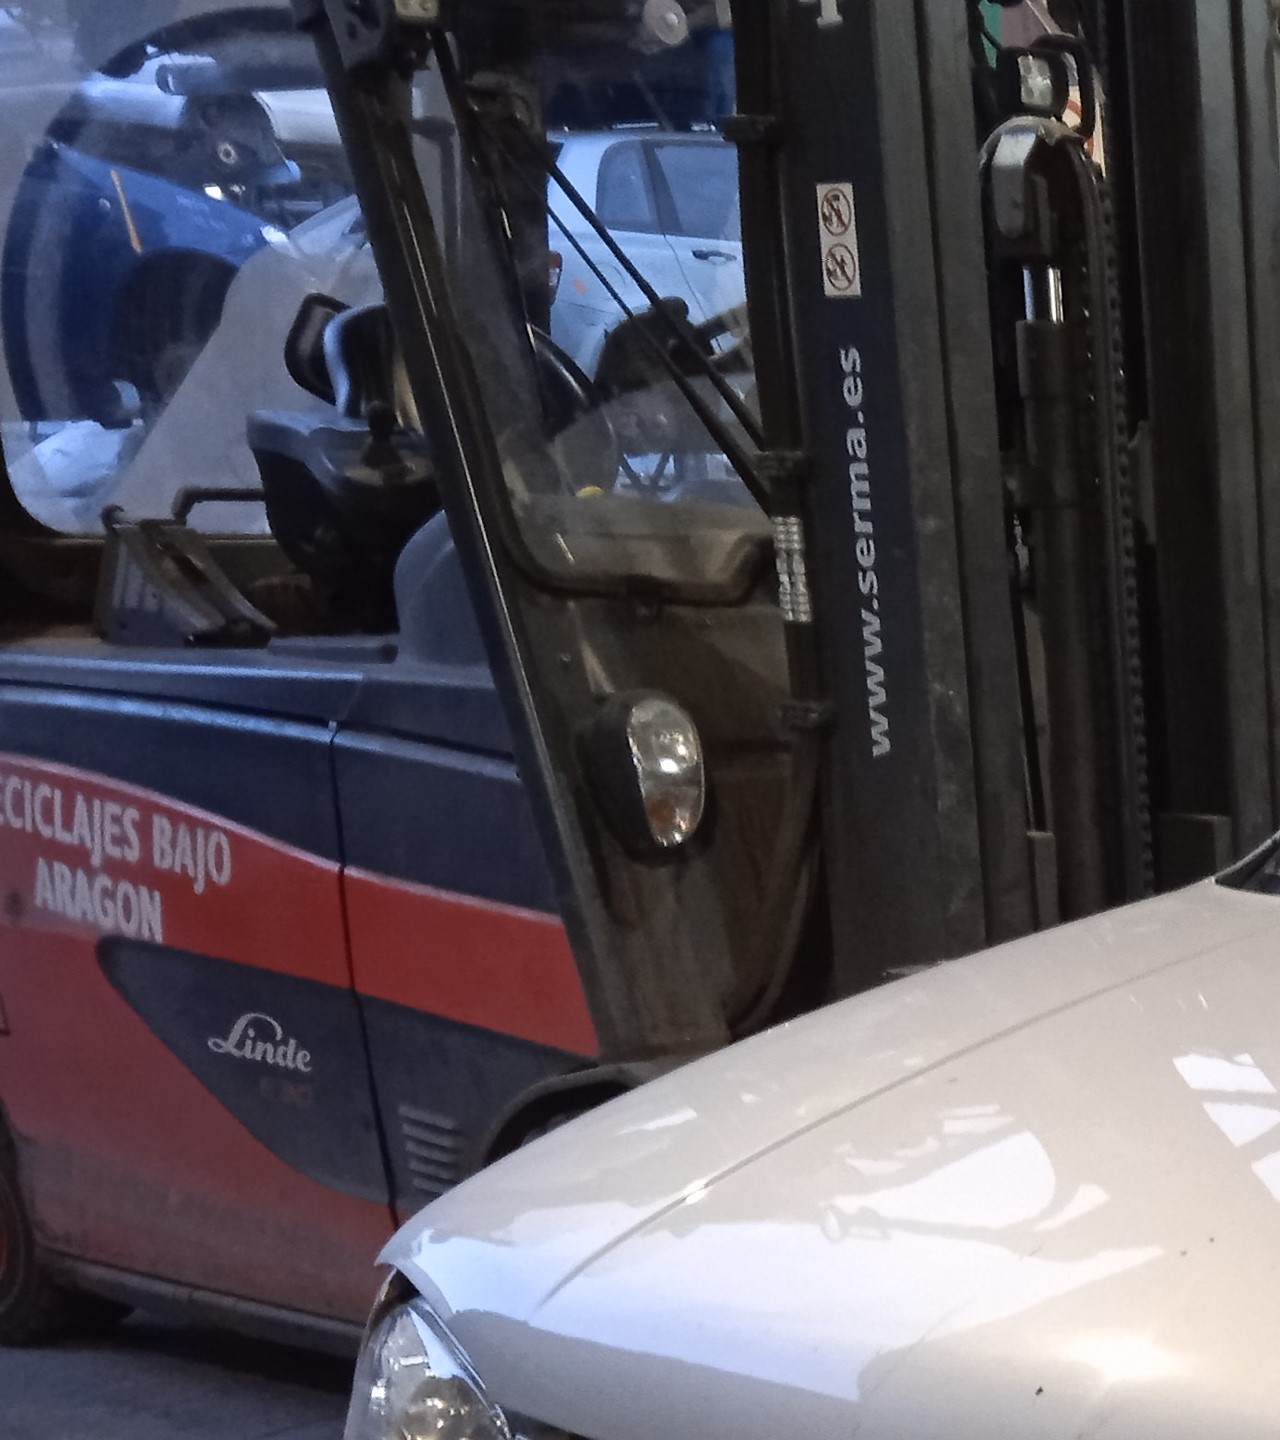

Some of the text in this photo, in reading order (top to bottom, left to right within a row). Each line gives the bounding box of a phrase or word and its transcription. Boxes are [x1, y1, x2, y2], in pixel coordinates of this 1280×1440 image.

[839, 347, 891, 758] www.serma.es
[0, 775, 232, 895] CICLAJES BAJO
[36, 856, 163, 944] ARAGON
[207, 1013, 312, 1072] Linde
